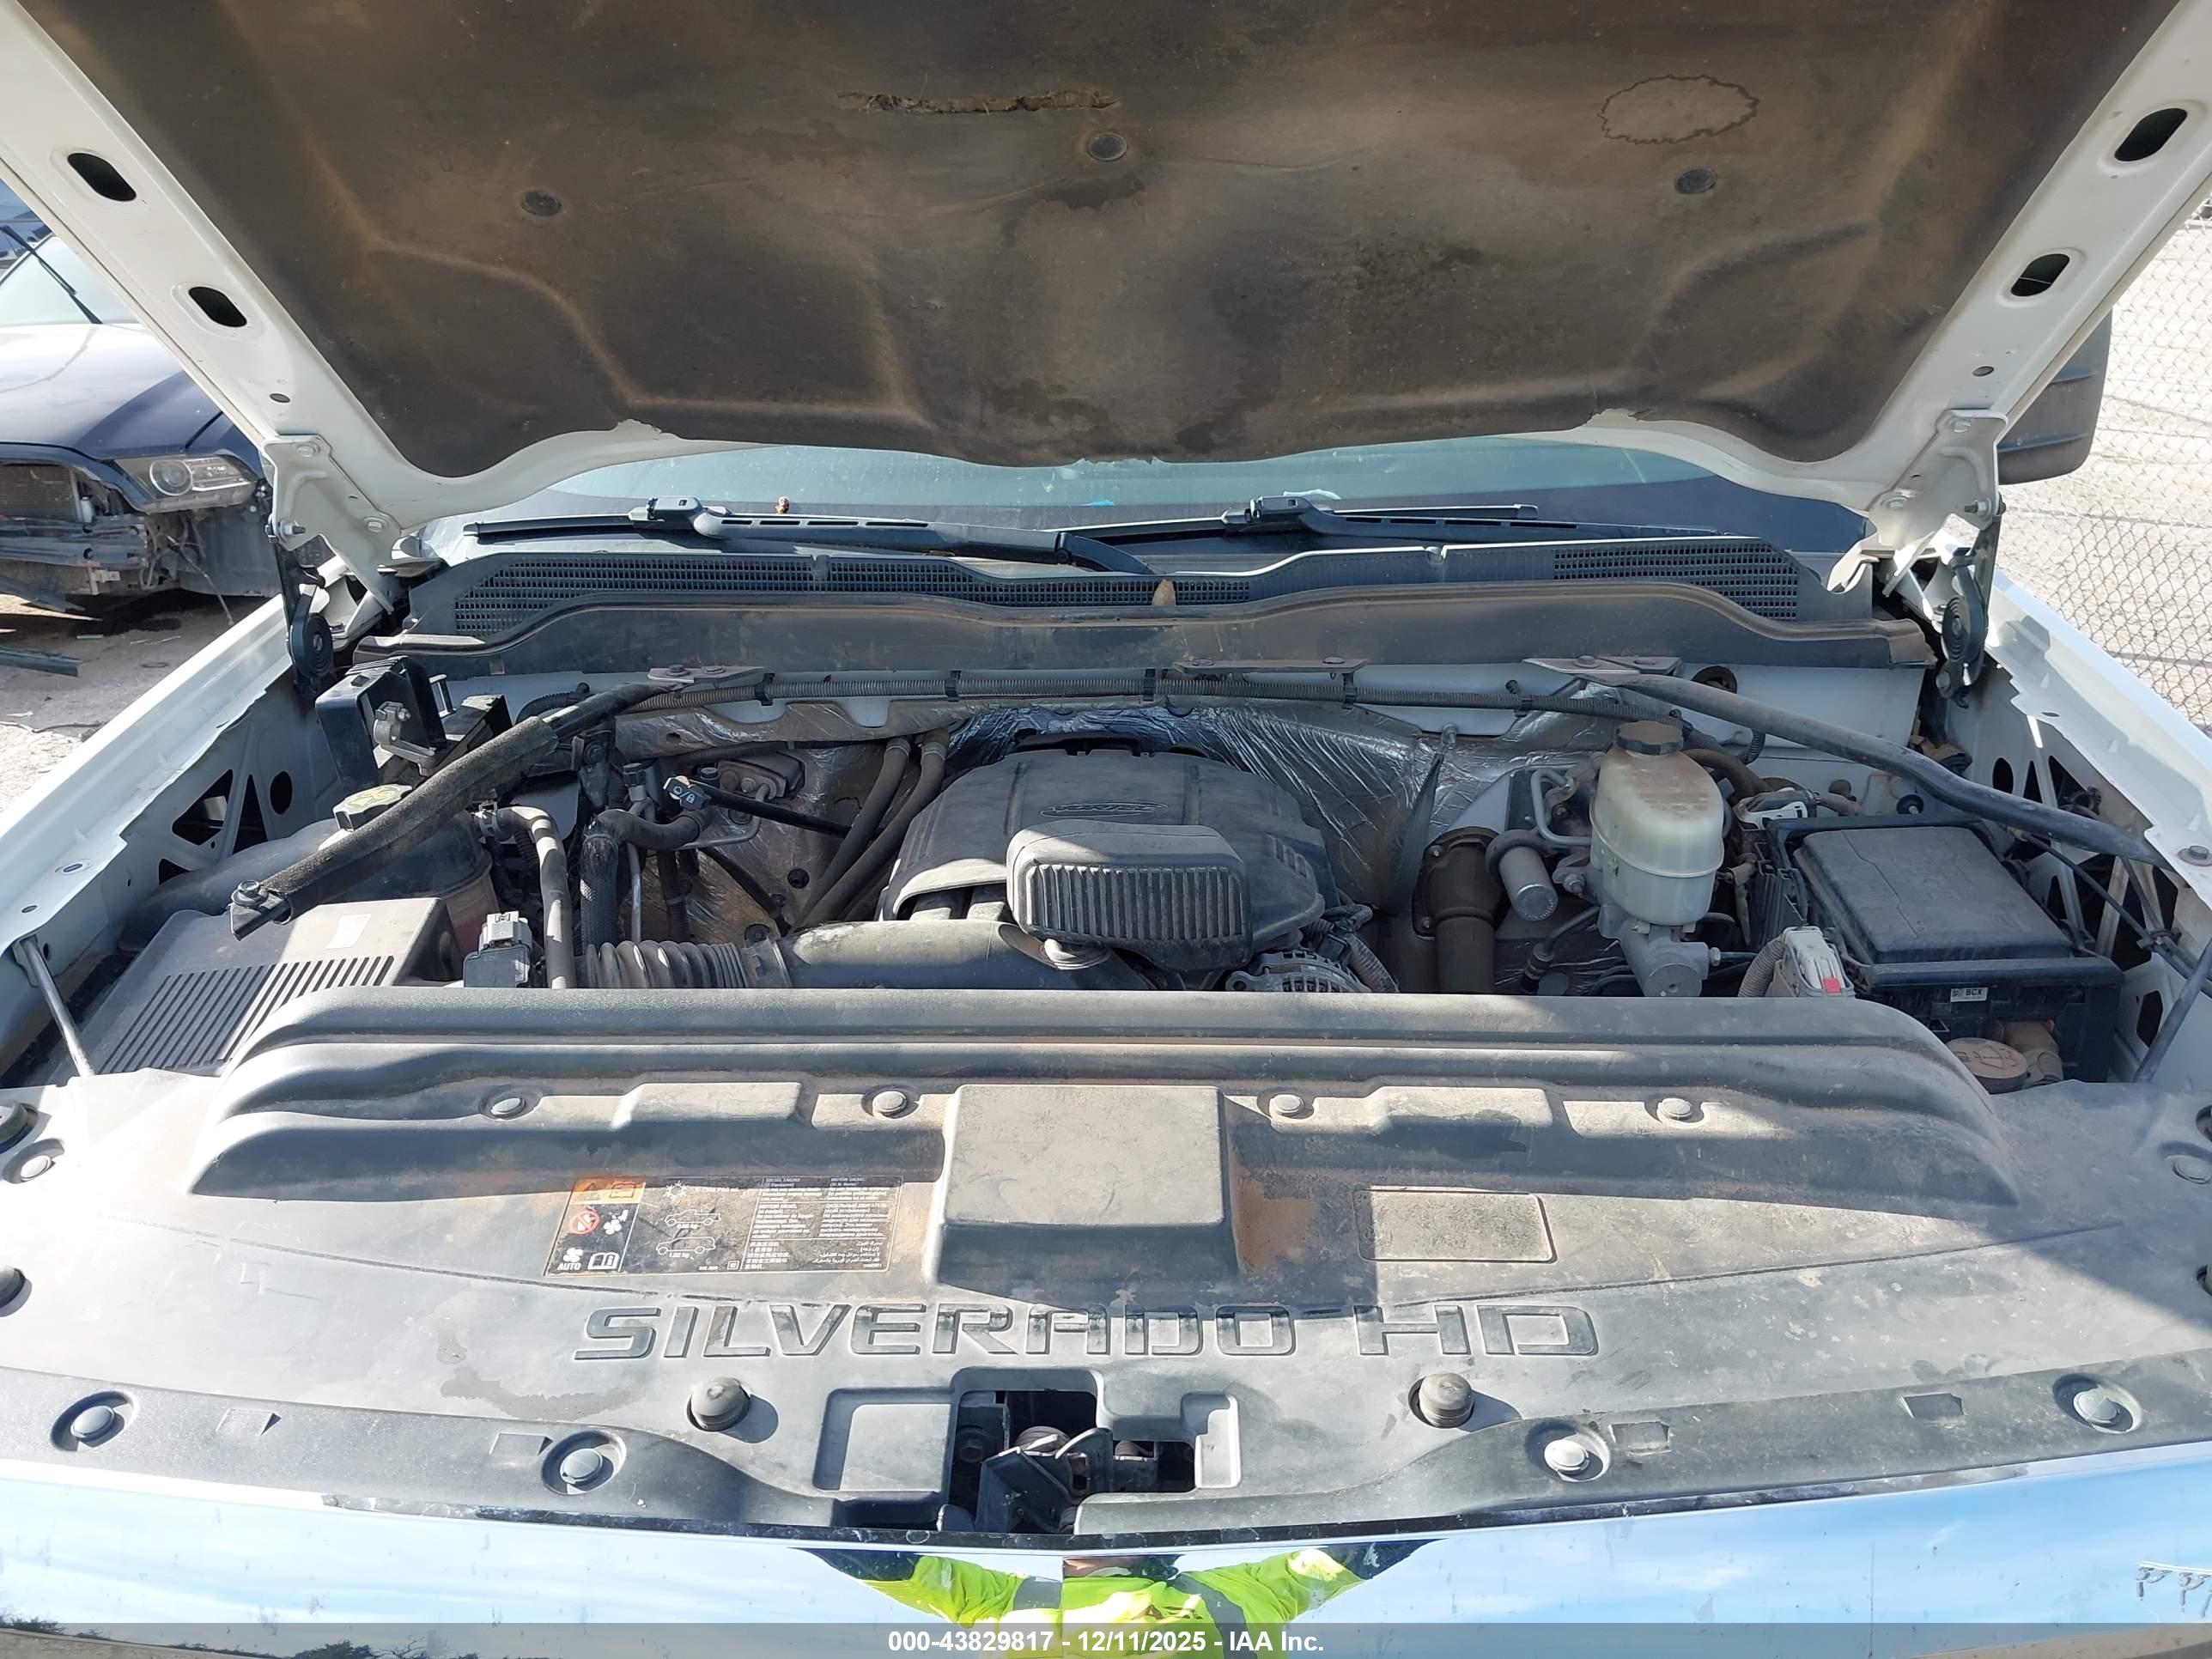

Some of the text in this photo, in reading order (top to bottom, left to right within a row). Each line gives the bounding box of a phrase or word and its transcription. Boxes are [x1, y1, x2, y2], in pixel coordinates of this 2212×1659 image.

[557, 1262, 581, 1271] AUTO
[574, 1304, 1600, 1360] SILVERADO HD
